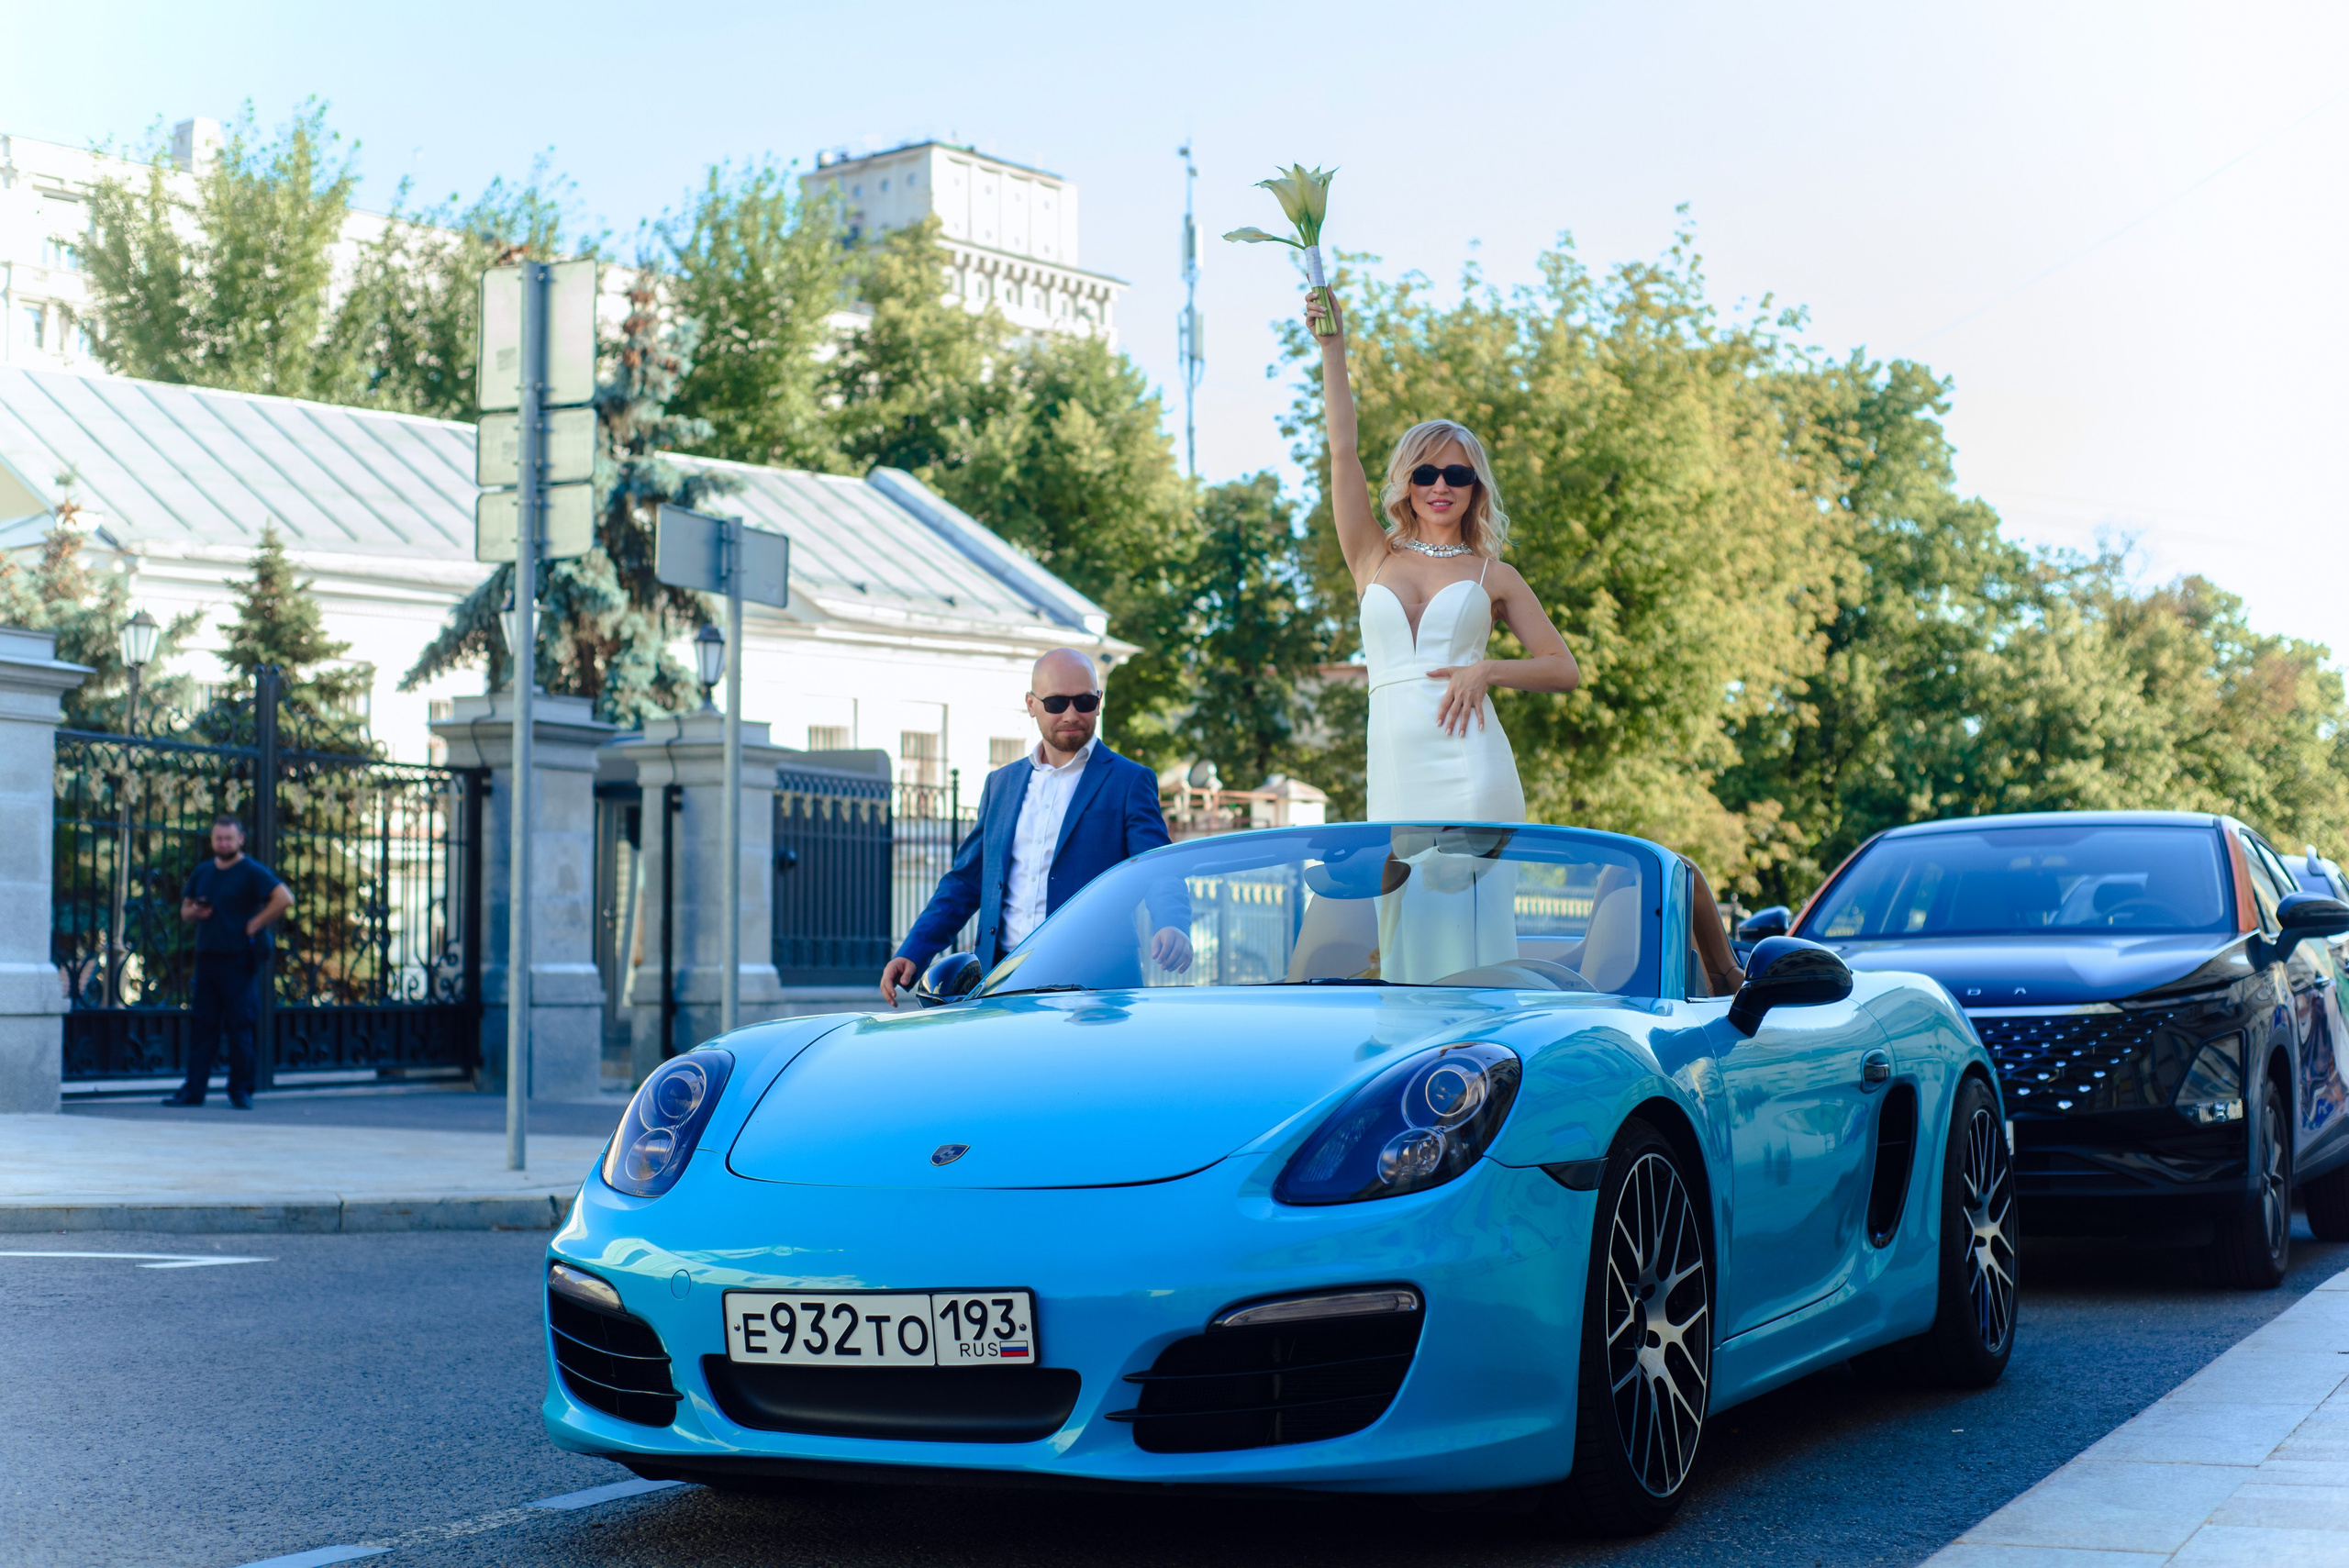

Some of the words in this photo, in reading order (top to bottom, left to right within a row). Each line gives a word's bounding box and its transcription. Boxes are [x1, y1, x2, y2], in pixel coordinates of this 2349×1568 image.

[742, 1301, 929, 1357] E932TO
[939, 1298, 1016, 1341] 193
[960, 1342, 999, 1358] RUS
